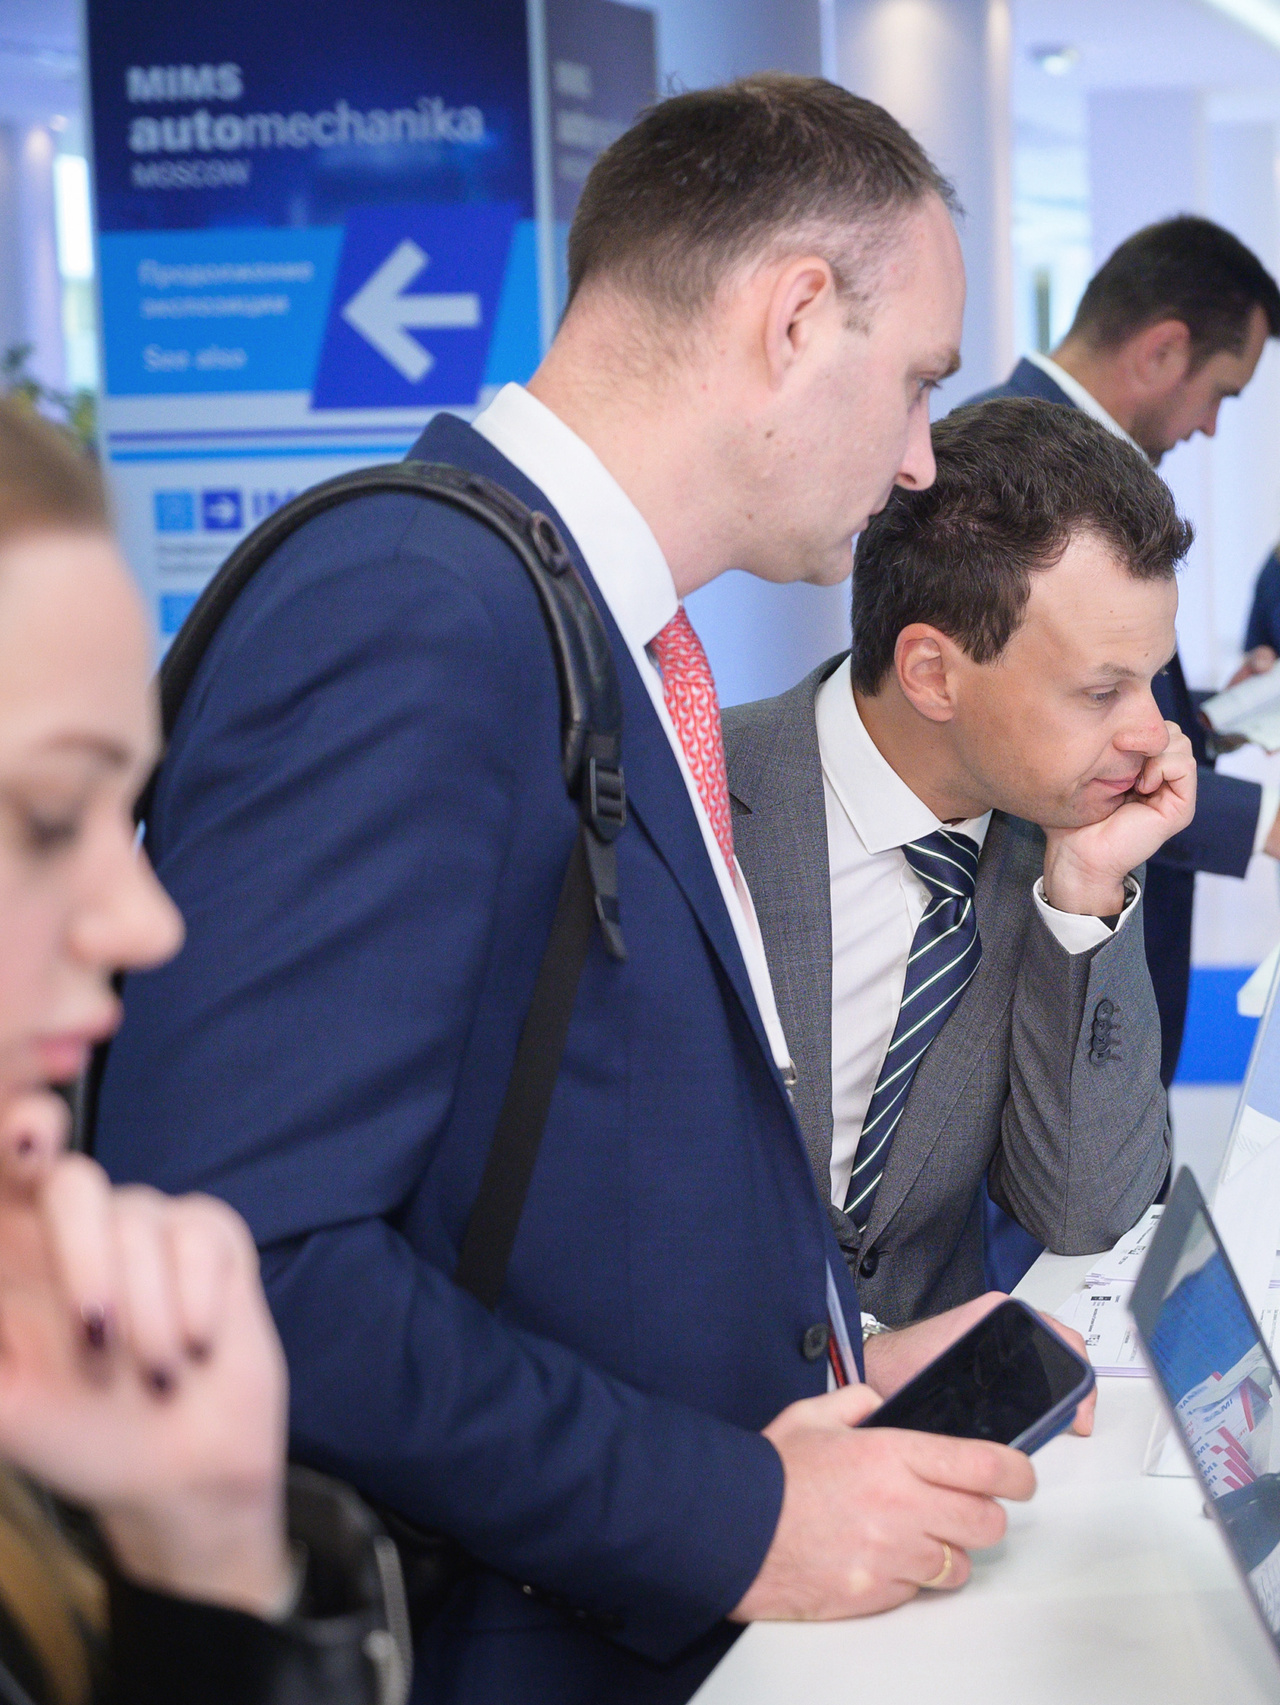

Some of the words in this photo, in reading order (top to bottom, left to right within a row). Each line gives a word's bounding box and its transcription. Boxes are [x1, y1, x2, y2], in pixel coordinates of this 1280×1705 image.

[126, 63, 244, 102] MIMS
[129, 97, 485, 153] automechanika
[131, 159, 252, 189] MOSCOW
[143, 344, 190, 372] See
[196, 344, 248, 371] also
